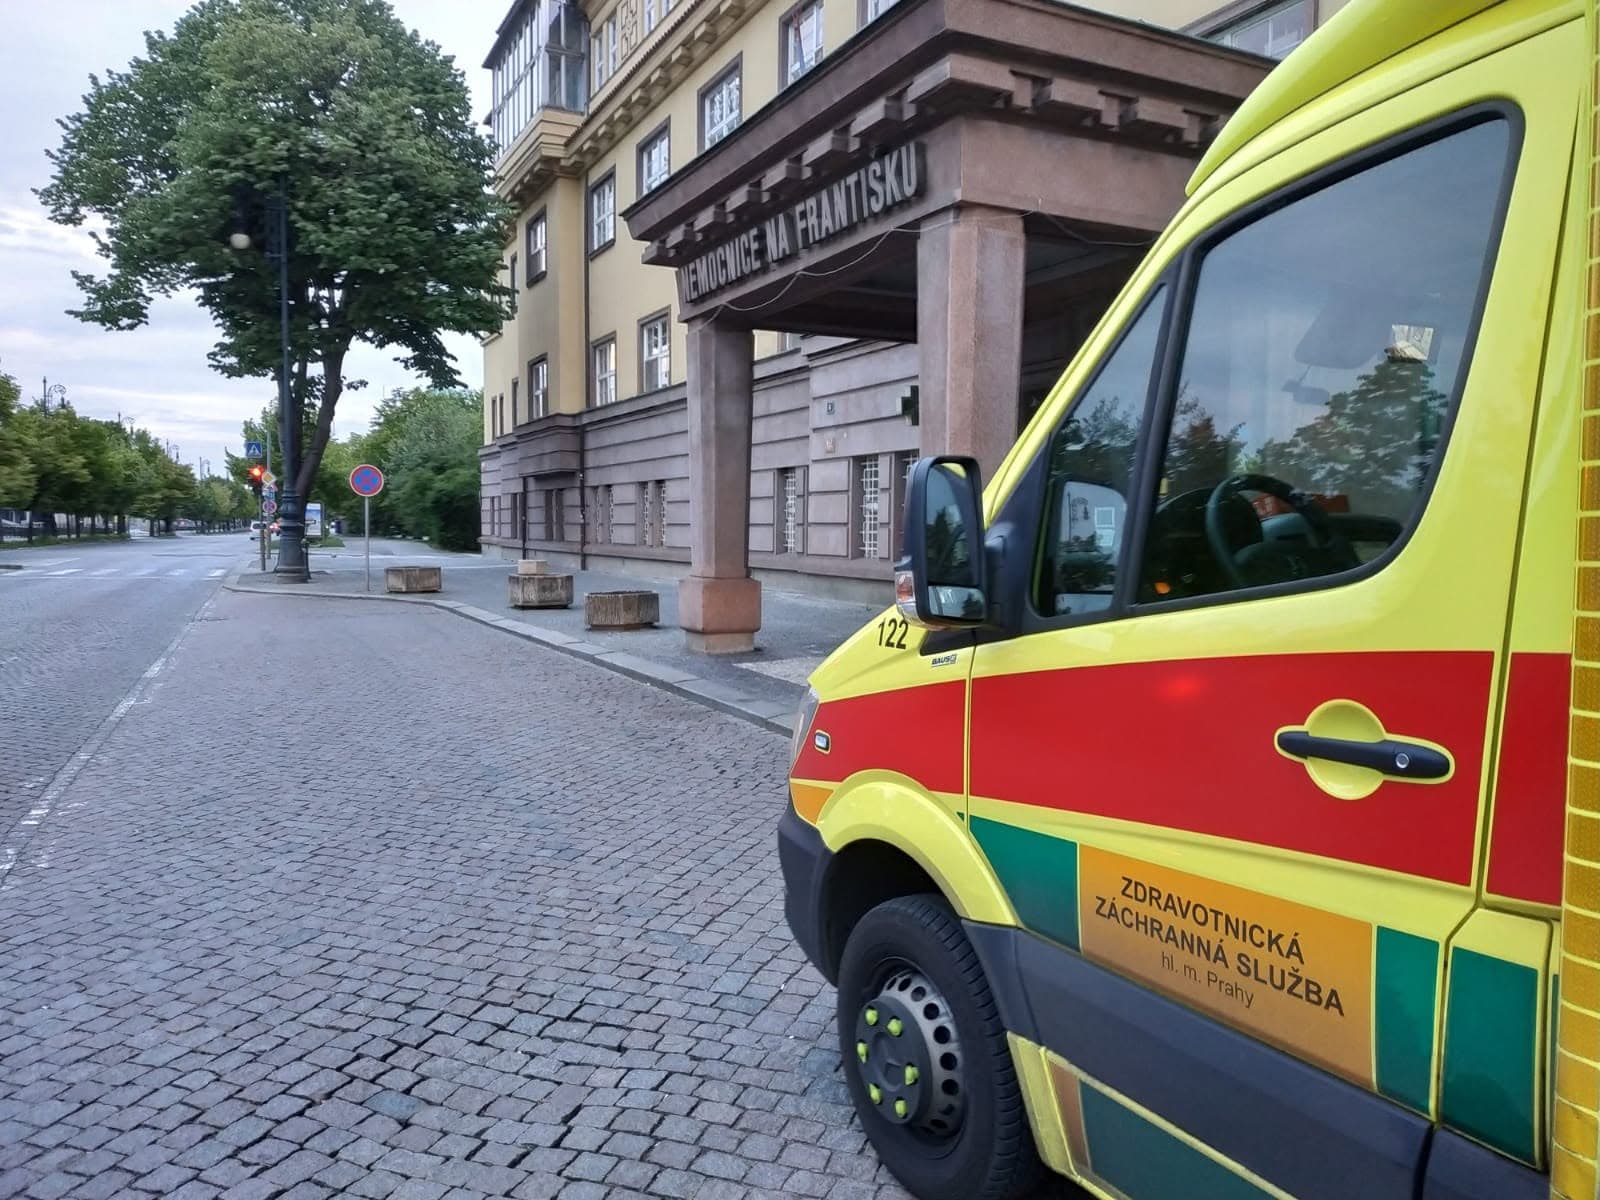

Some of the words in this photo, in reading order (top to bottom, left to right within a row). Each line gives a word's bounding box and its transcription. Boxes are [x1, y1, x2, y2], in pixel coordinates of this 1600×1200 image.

[680, 227, 761, 302] NEMOCNICE
[765, 213, 790, 264] NA
[878, 617, 909, 650] 122
[1095, 895, 1229, 969] ZÁCHRANNÁ
[1236, 952, 1345, 1017] SLUŽBA
[1121, 876, 1305, 965] ZDRAVOTNICKÁ
[1161, 952, 1178, 973] hl.
[1183, 964, 1201, 984] m.
[1207, 971, 1254, 1009] Prahy
